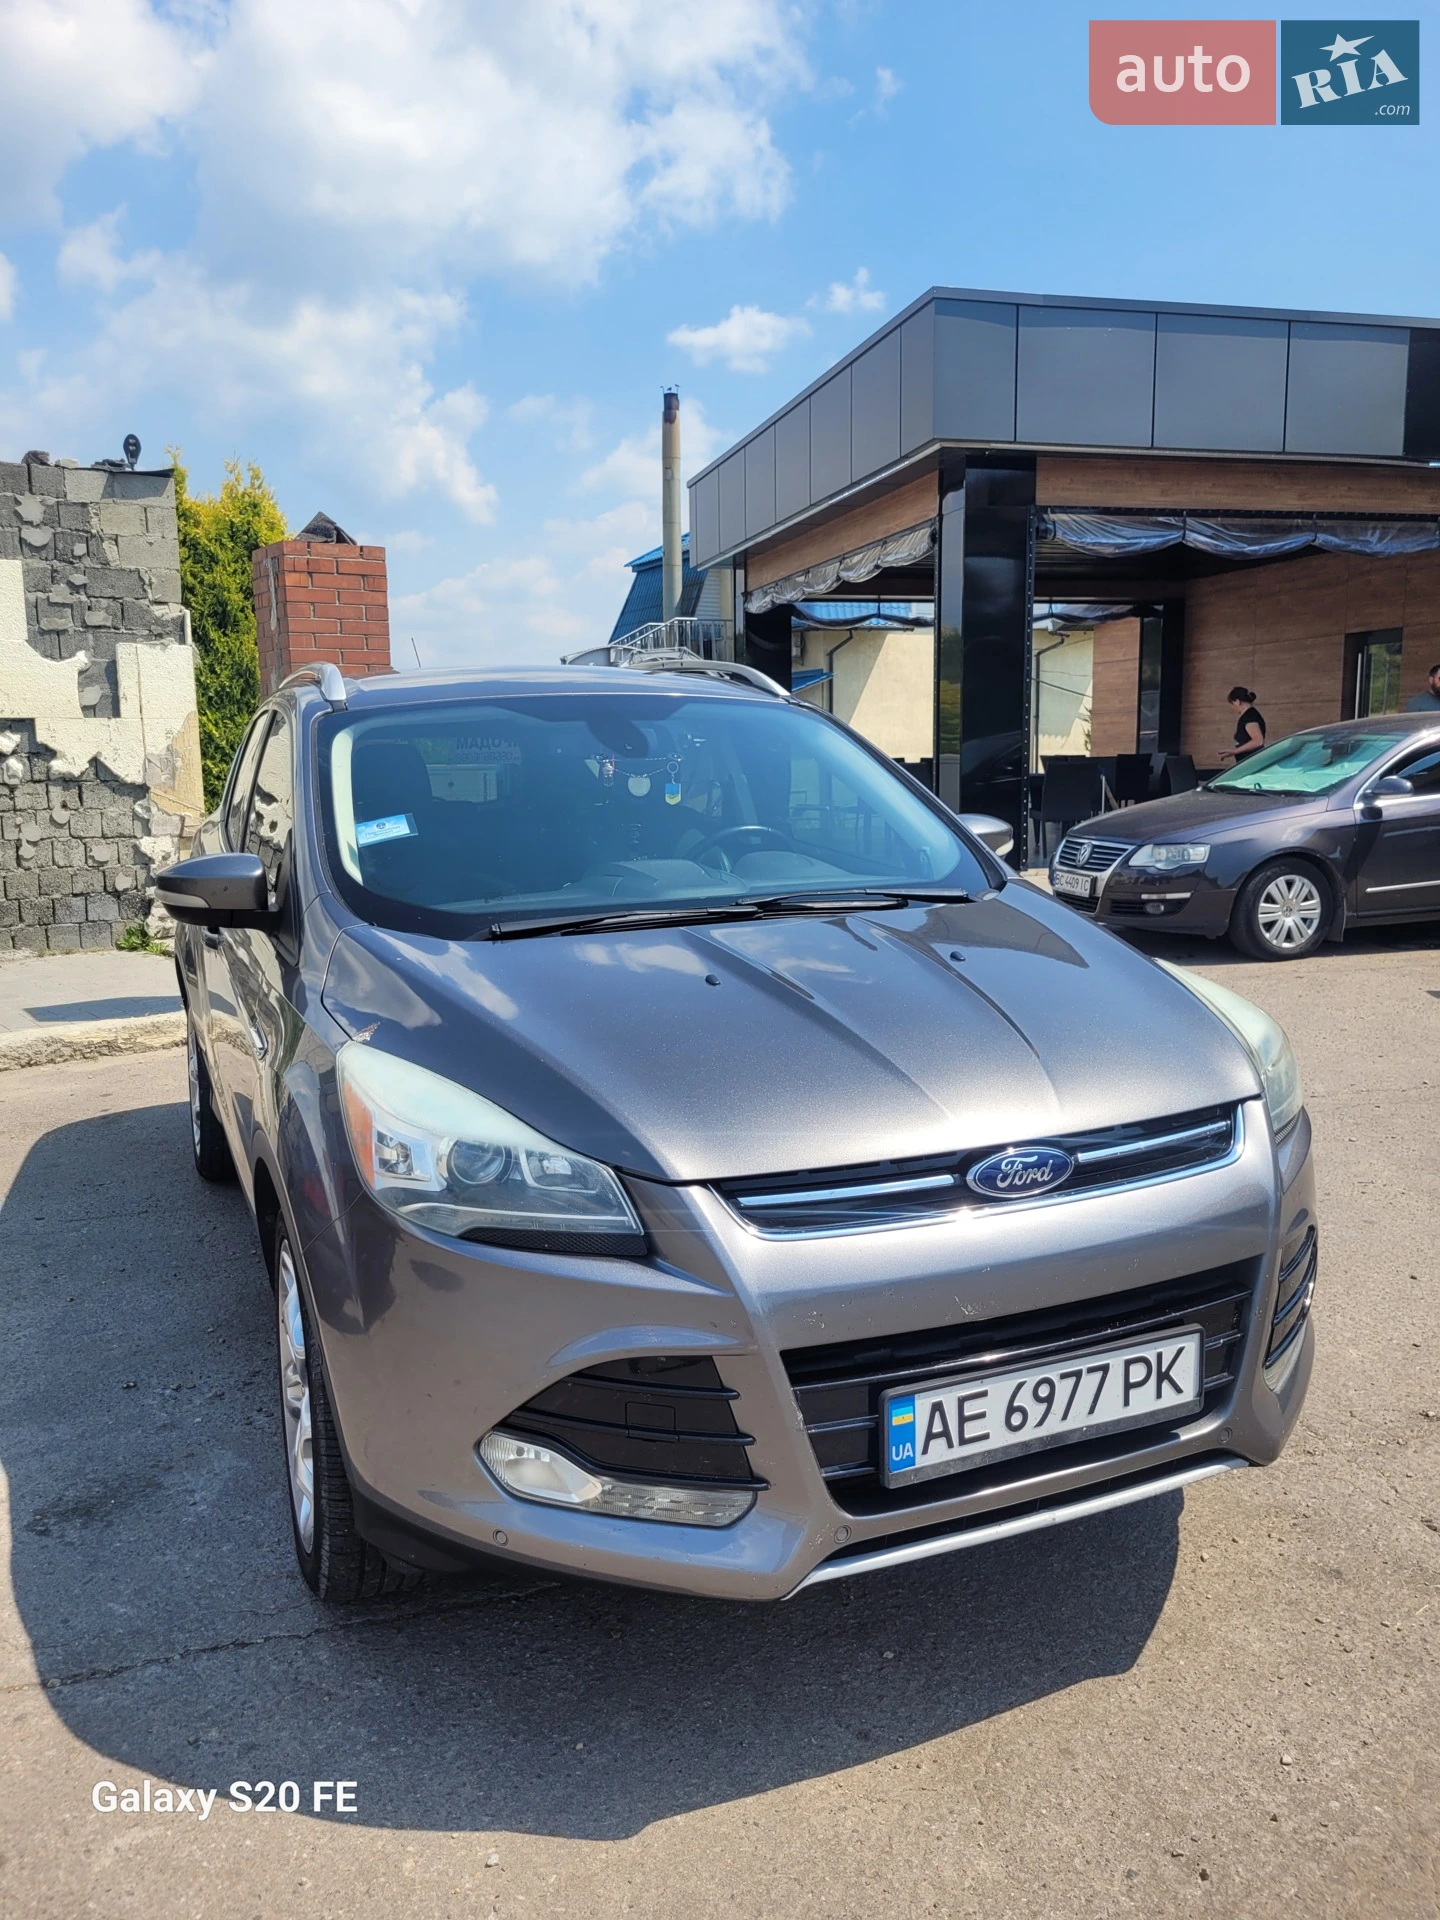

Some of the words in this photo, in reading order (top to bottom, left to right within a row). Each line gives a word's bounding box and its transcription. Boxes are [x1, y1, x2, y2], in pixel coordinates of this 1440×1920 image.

[1065, 875, 1080, 890] 4409
[996, 1155, 1054, 1188] Ford
[921, 1388, 991, 1456] AE
[1004, 1361, 1111, 1433] 6977
[1122, 1345, 1187, 1408] PK
[892, 1442, 914, 1462] UA
